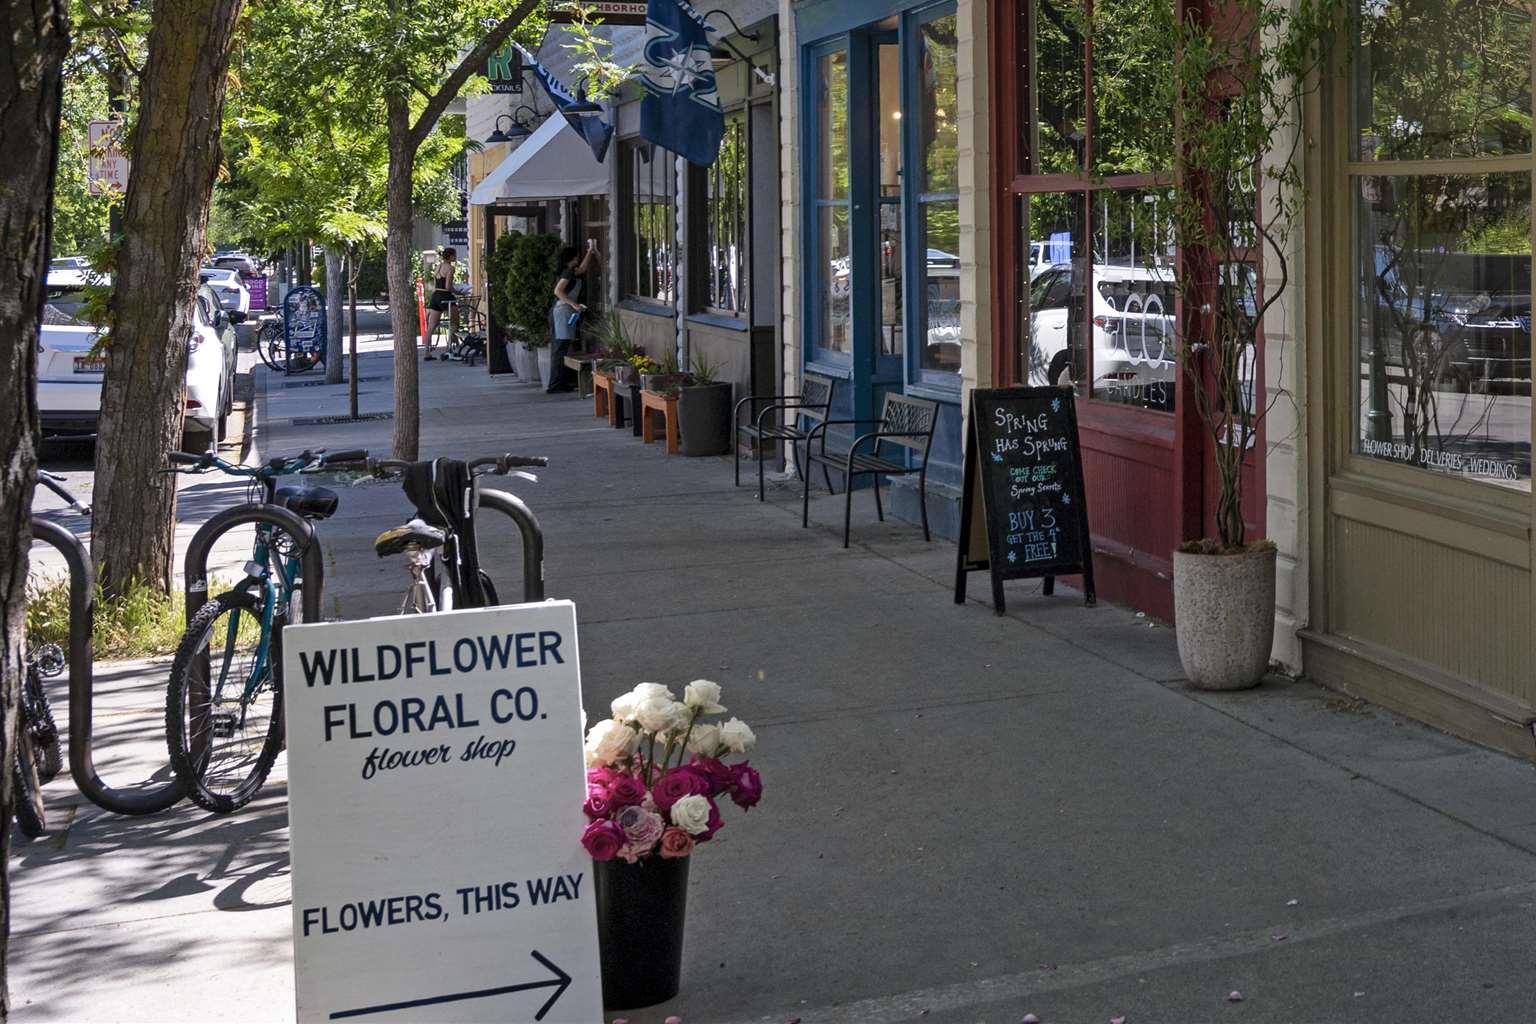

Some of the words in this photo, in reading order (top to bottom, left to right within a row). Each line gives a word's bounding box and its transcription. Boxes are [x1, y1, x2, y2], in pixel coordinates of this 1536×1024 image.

[100, 170, 119, 179] TIME
[995, 407, 1048, 434] SPRING
[995, 438, 1020, 454] HAS
[1023, 436, 1068, 461] SPRUNG
[1363, 439, 1392, 458] FLOWER
[1393, 443, 1415, 462] SHOP
[1470, 457, 1518, 480] WEDDINGS
[1032, 465, 1057, 475] CHECK
[1008, 510, 1034, 531] BUY
[1041, 508, 1056, 528] 3
[1007, 532, 1024, 544] GET
[1025, 530, 1045, 543] THE
[299, 630, 566, 688] WILDFLOWER
[324, 692, 479, 742] FLORAL
[490, 686, 548, 725] CO.
[361, 744, 452, 780] flower
[459, 733, 516, 767] shop
[302, 893, 450, 937] FLOWERS,
[456, 882, 521, 915] THIS
[527, 873, 584, 905] WAY
